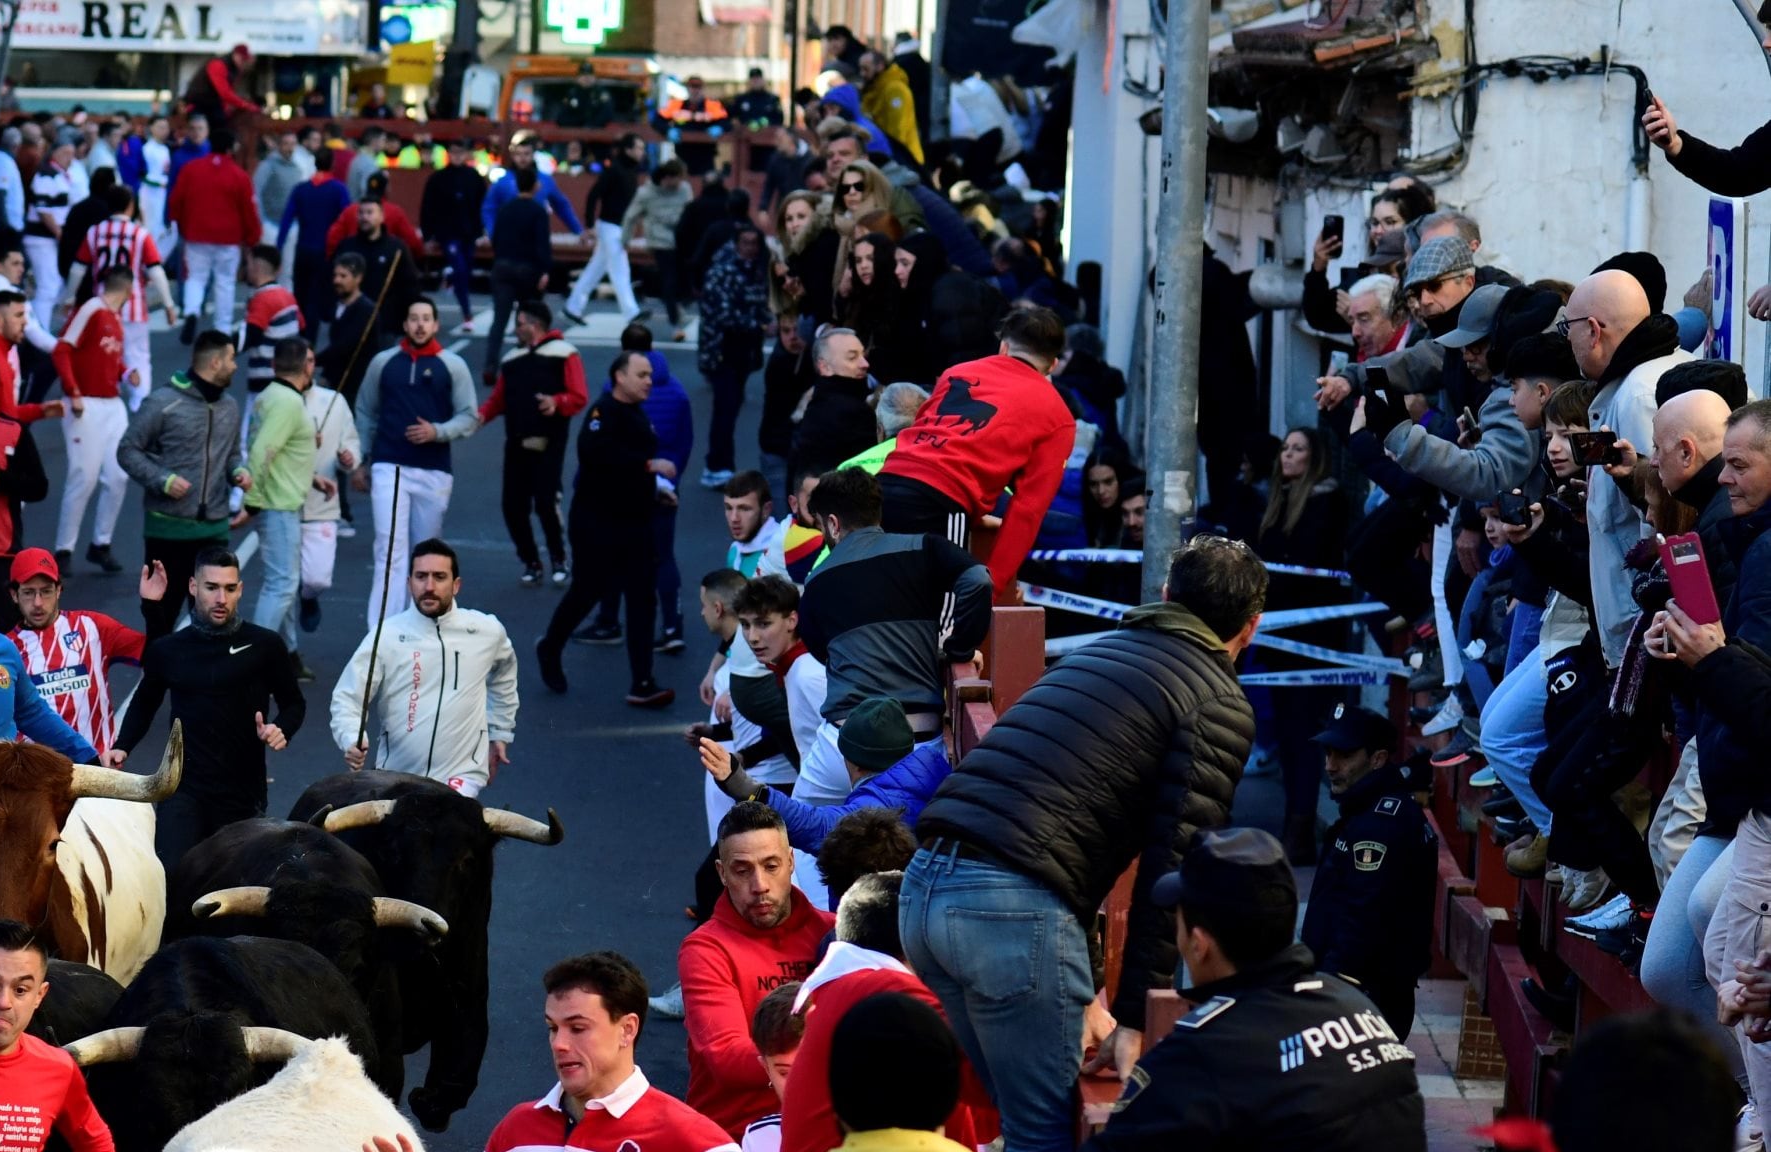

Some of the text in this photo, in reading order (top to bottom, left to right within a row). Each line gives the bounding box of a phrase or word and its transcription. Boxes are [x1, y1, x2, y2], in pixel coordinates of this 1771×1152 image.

[82, 2, 221, 41] REAL
[40, 667, 77, 683] Trade
[407, 651, 421, 733] PASTORES
[1302, 1009, 1399, 1058] POLICÍA
